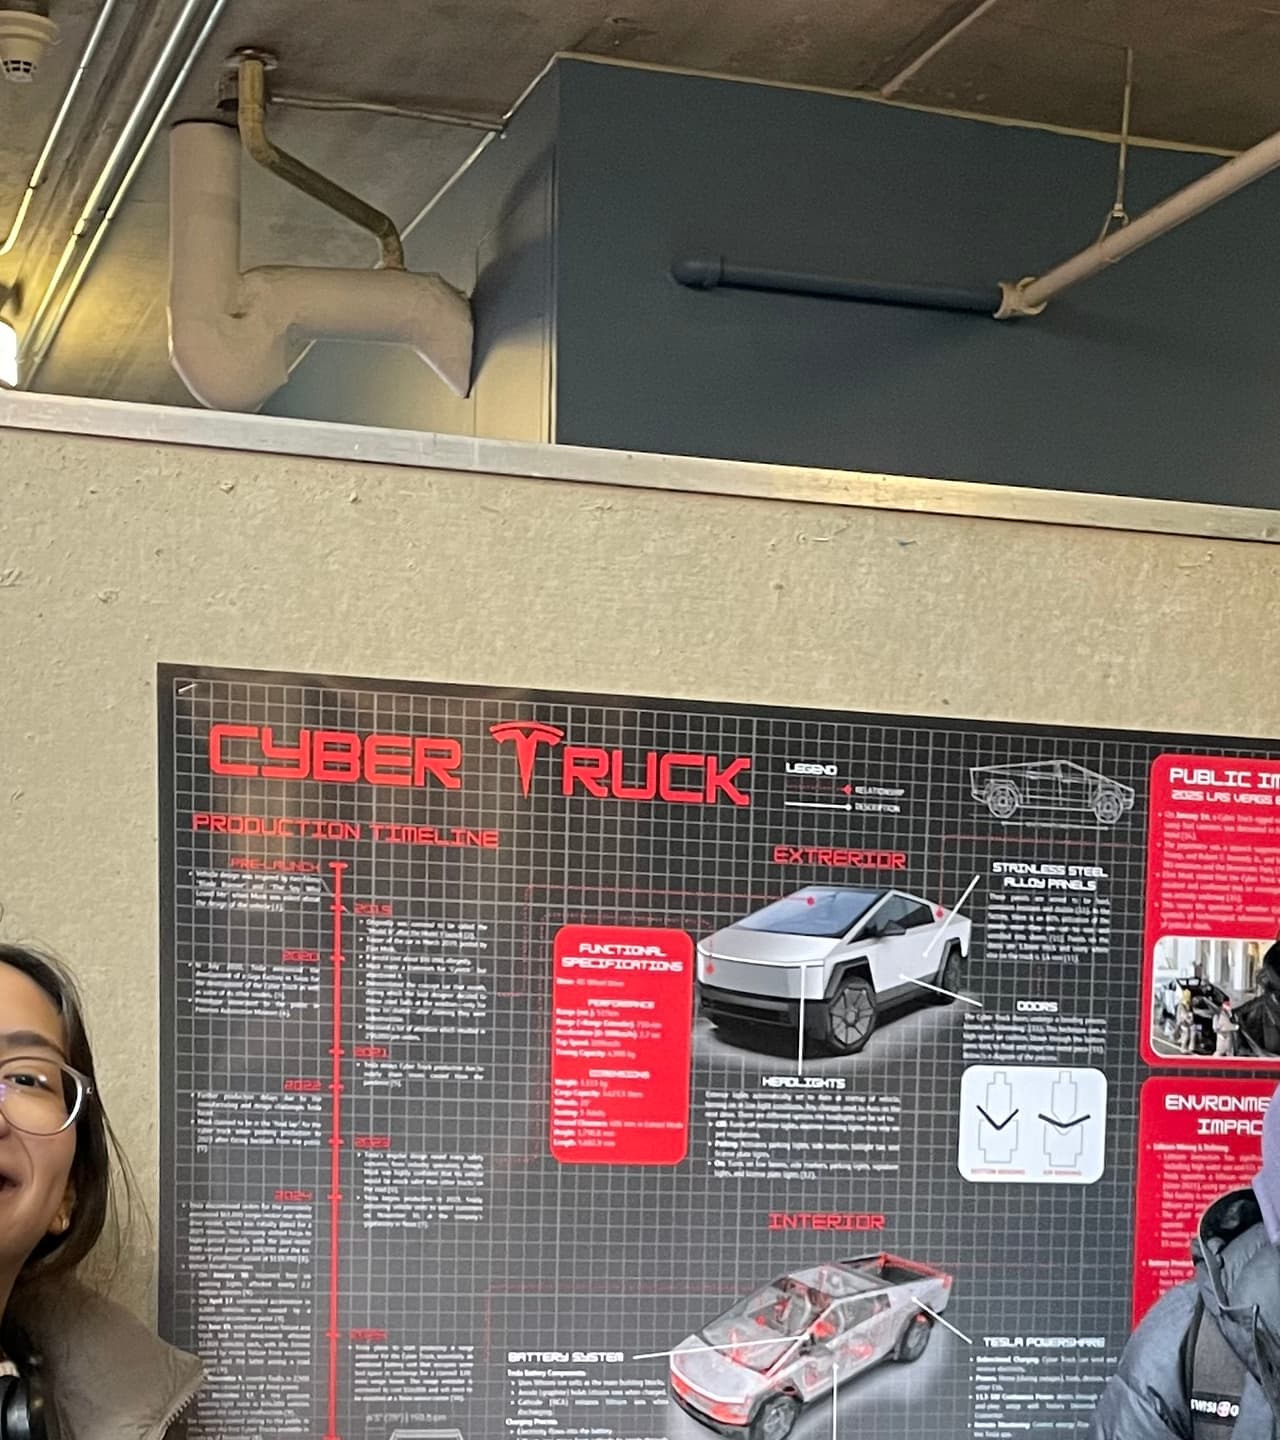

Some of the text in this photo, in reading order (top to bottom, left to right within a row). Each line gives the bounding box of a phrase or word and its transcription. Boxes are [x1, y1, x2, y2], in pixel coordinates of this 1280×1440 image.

[208, 724, 462, 789] CYBER
[785, 762, 838, 776] LEGEND
[1169, 767, 1252, 789] PUBLIC
[191, 813, 500, 849] PRODUCTION TIMELINE
[773, 846, 907, 870] EXTRERIOR
[1067, 866, 1109, 879] STEEL
[1003, 876, 1098, 892] ALLOY PANELS
[579, 943, 667, 957] FUNCTIONAL
[561, 957, 684, 972] SPECIFICATIONS
[1016, 1001, 1059, 1013] DOORS
[762, 1076, 847, 1090] HEADLIGHTS
[768, 1211, 886, 1231] INTERIOR
[983, 1337, 1024, 1348] TESLA
[507, 1352, 625, 1363] BATTERY SYSTEM
